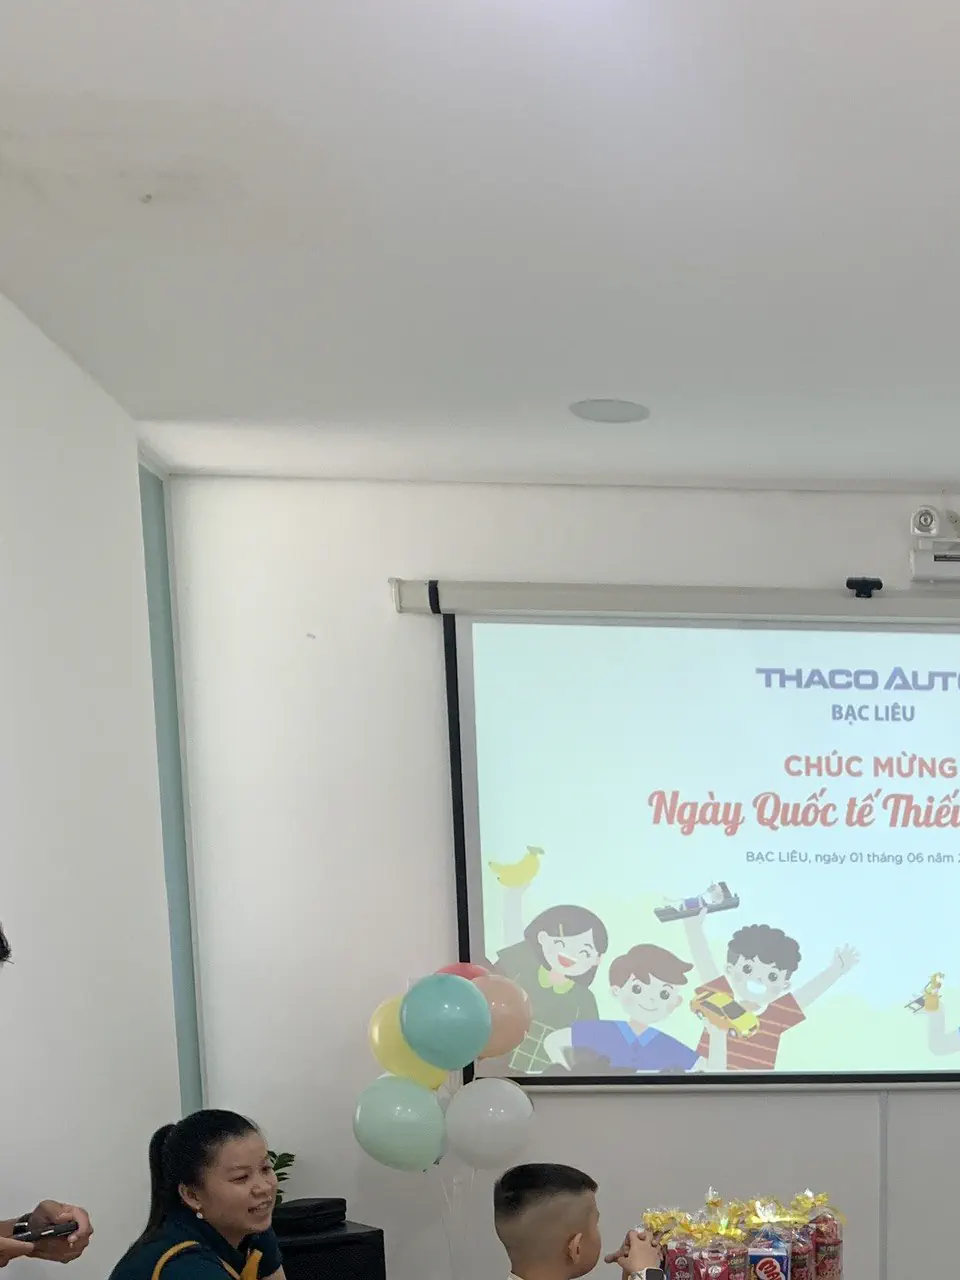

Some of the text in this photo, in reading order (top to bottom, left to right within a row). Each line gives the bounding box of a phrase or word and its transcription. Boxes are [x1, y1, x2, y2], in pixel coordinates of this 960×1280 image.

[756, 667, 879, 690] THACO
[832, 702, 915, 726] BẠC LIÊU
[784, 749, 959, 779] CHÚC MỪNG
[647, 790, 745, 837] Ngày
[752, 787, 839, 831] Quốc
[845, 788, 883, 828] tế
[746, 851, 775, 864] BẠC
[778, 849, 812, 864] LIÊU,
[815, 852, 846, 864] ngày
[850, 852, 864, 863] 01
[867, 852, 903, 865] tháng
[907, 852, 924, 863] 06
[928, 852, 954, 863] năm
